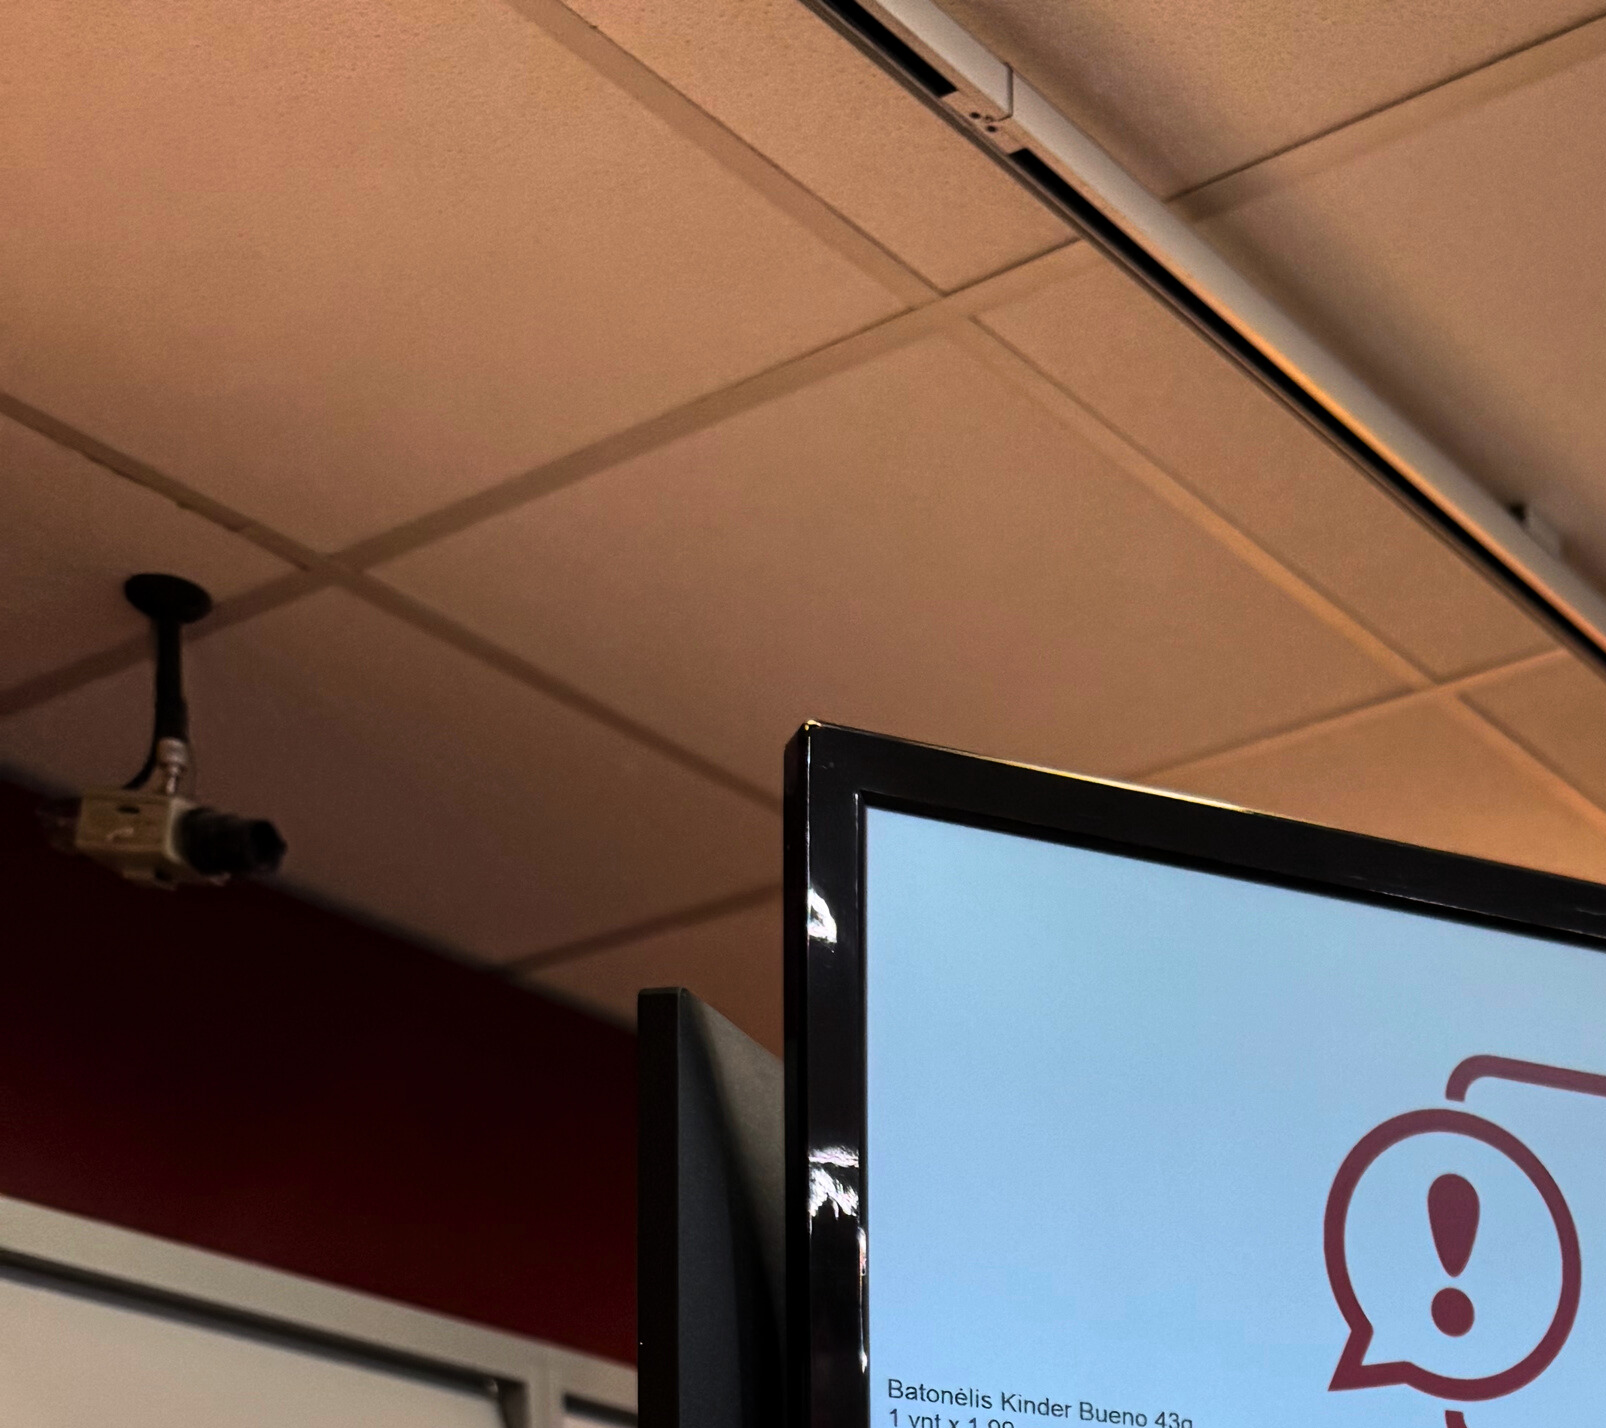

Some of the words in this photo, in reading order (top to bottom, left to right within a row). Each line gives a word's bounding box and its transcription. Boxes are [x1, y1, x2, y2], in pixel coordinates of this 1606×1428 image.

[888, 1378, 993, 1411] Batonėlis
[1001, 1393, 1073, 1420] Kinder
[1079, 1402, 1148, 1428] Bueno
[890, 1409, 899, 1427] 1
